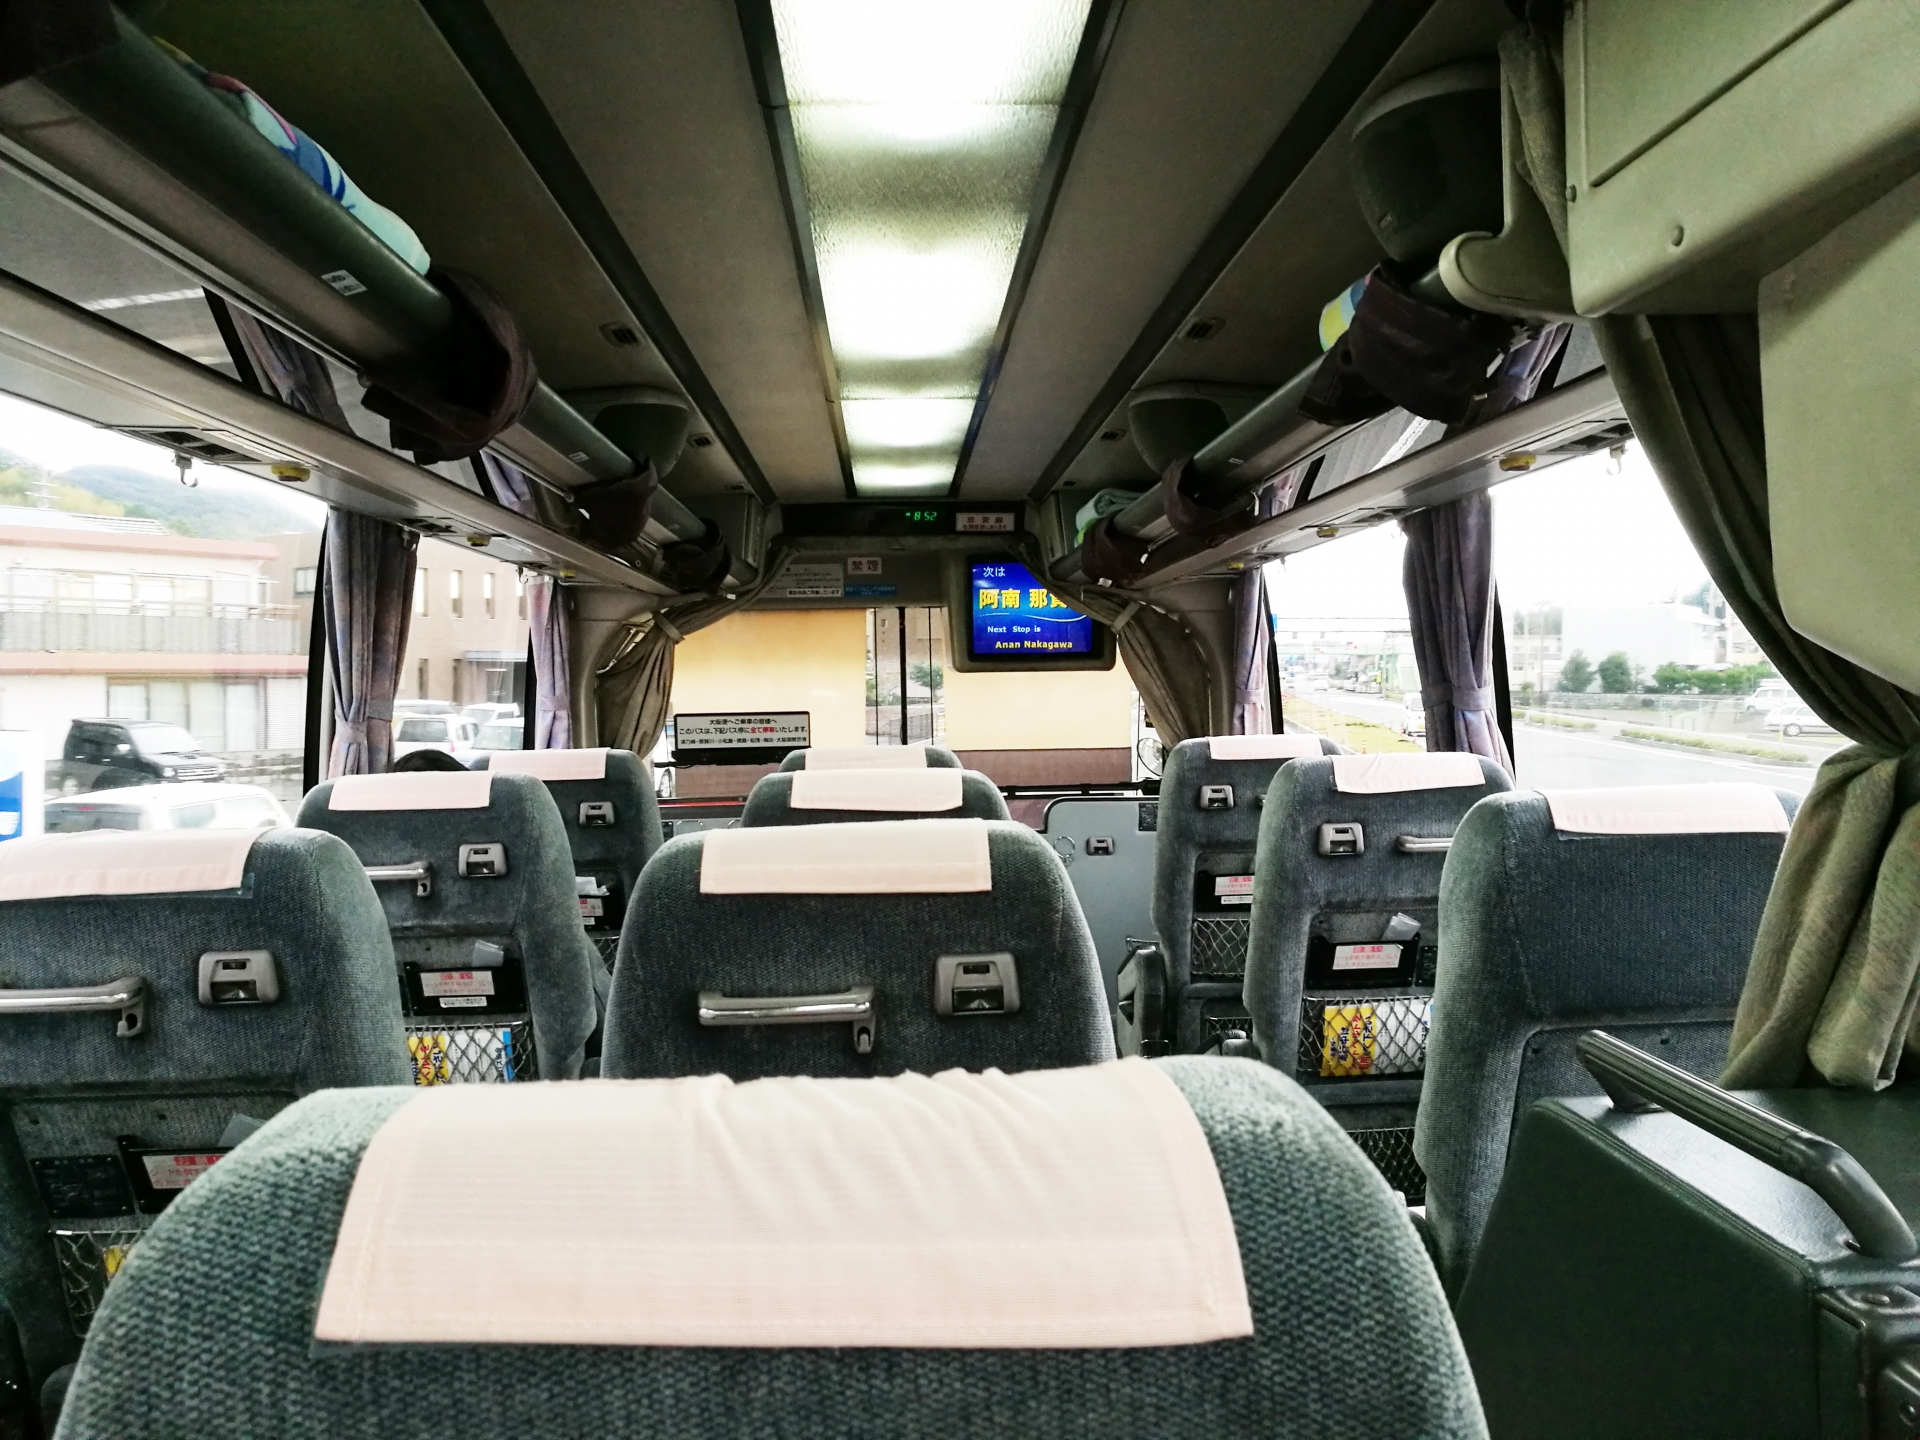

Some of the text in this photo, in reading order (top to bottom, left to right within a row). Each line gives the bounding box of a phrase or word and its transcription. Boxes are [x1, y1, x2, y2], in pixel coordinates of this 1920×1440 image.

[851, 559, 879, 572] 禁煙
[983, 567, 1006, 577] 次は
[979, 588, 1021, 609] 阿南
[987, 625, 1041, 634] Next Stop is
[995, 640, 1073, 650] Anan Nakagawa
